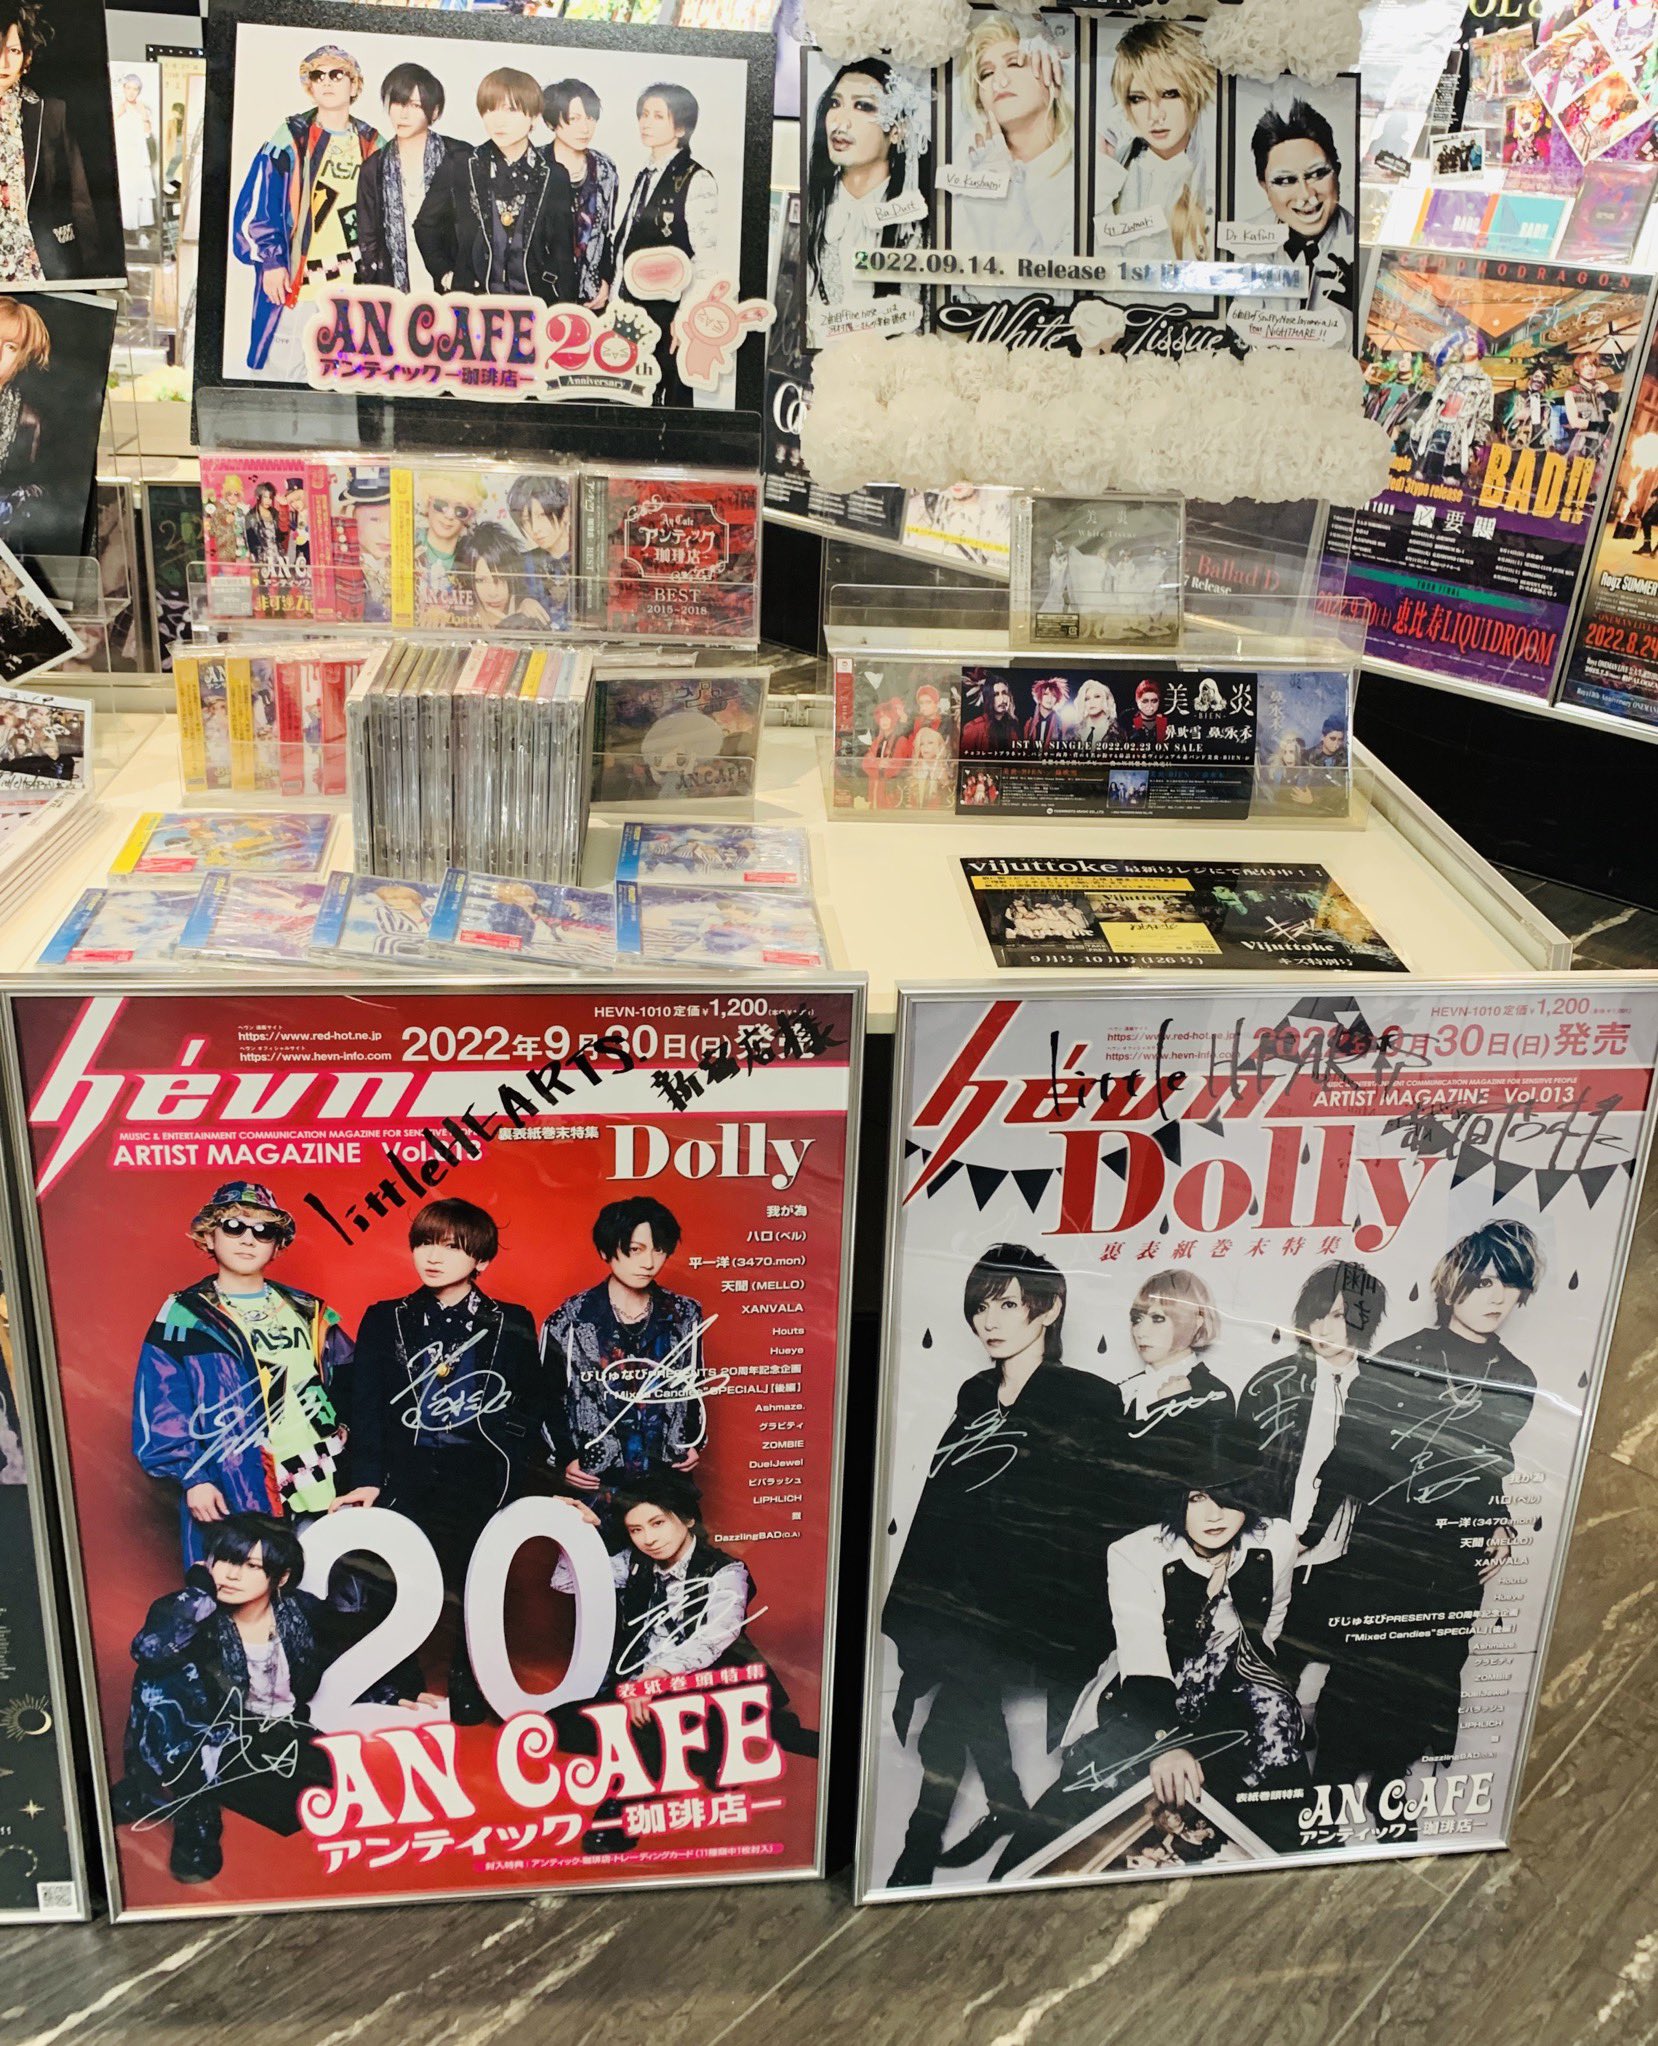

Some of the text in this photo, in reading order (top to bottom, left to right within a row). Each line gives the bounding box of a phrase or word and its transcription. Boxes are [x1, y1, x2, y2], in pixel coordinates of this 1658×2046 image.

[854, 250, 1152, 281] 2022.09.14. Release 1st
[939, 292, 1077, 350] White
[317, 298, 536, 365] AN CAFE
[1124, 306, 1231, 357] Tissue
[565, 375, 628, 392] Anniversary
[1480, 443, 1596, 524] BAD!!
[639, 527, 716, 553] アンティック
[1198, 555, 1259, 587] Ballad
[654, 587, 702, 603] BEST
[1191, 577, 1232, 596] Release
[1049, 740, 1092, 752] SINGLE
[1096, 741, 1152, 752] 2022.02.23
[1155, 742, 1171, 752] ON
[1174, 743, 1204, 753] SALE
[968, 859, 1119, 875] vijuttoke
[594, 1005, 672, 1018] HEVN-1010
[674, 1005, 701, 1017] 定価
[1431, 1006, 1501, 1018] HEVN-1010
[1503, 1004, 1528, 1016] 定価
[238, 1030, 382, 1042] https://www.red-hot.ne.jp
[239, 1051, 392, 1063] https://www.hevn-info.com
[1469, 1077, 1506, 1086] MAGAZINE
[1507, 1077, 1521, 1085] FOR
[1522, 1077, 1553, 1085] SENSITIVE
[1554, 1076, 1578, 1084] PEOPLE
[1313, 1086, 1575, 1107] ARTIST MAGAZINE Vol.013
[119, 1129, 402, 1141] MUSIC & ENTERTAINMENT COMMUNICATION MAGAZINE FOR
[113, 1143, 199, 1167] ARTIST
[206, 1142, 362, 1165] MAGAZINE
[605, 1122, 817, 1191] Dolly
[1041, 1123, 1447, 1253] Dolly
[766, 1205, 808, 1218] 我が為
[1099, 1236, 1344, 1262] 裏表紙巻末特集
[742, 1303, 804, 1315] XANVALA
[755, 1403, 806, 1413] Ashmaze.
[761, 1439, 805, 1450] ZOMBIE
[748, 1457, 804, 1469] DuelJewel
[752, 1494, 802, 1505] LIPHLICH
[1474, 1556, 1529, 1567] XANVALA
[1328, 1611, 1446, 1628] びじゅなびPRESENTS
[618, 1665, 767, 1700] 表紙巻頭特集
[300, 1724, 475, 1837] AN
[498, 1686, 784, 1809] CAFE
[1298, 1772, 1494, 1830] AN CAFE
